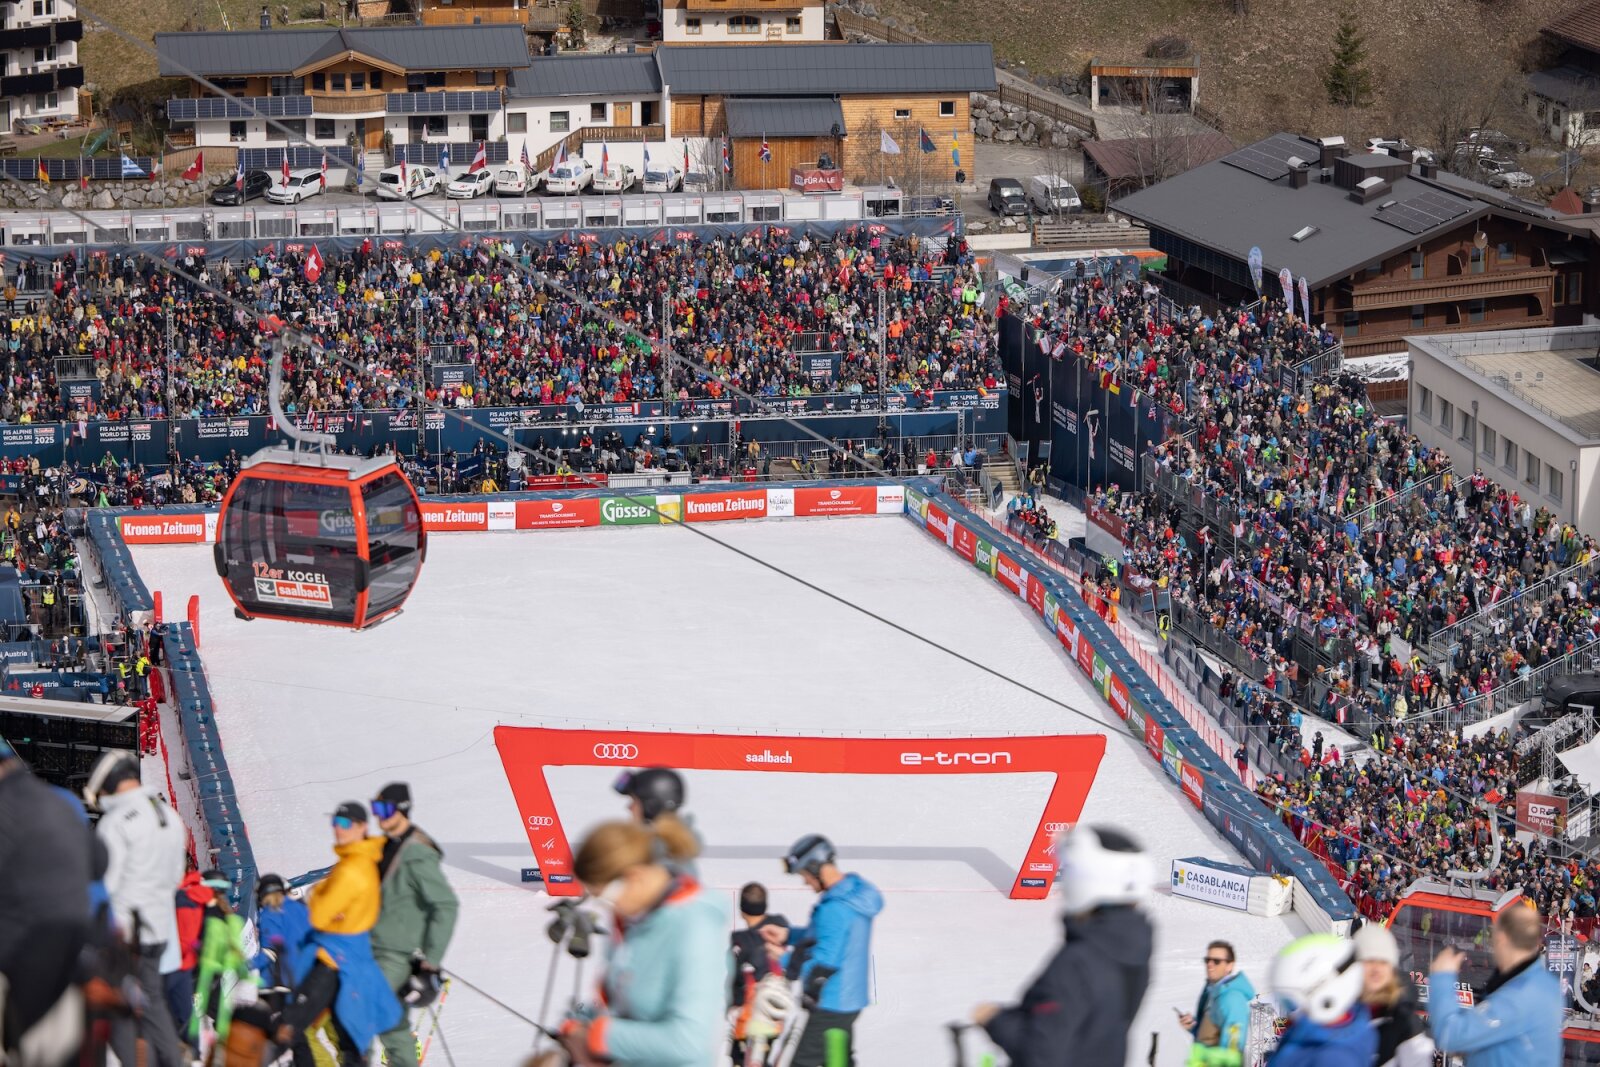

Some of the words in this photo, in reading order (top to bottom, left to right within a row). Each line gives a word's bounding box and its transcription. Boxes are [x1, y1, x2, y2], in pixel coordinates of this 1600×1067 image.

[34, 436, 54, 444] 2025
[132, 433, 151, 441] 2025
[229, 429, 249, 437] 2025
[602, 499, 654, 522] Gösser
[687, 499, 724, 514] Kronen
[725, 497, 765, 512] Zeitung
[445, 509, 485, 524] Zeitung
[124, 522, 162, 536] Kronen
[162, 521, 203, 536] Zeitung
[252, 562, 284, 580] 12er
[287, 570, 329, 584] KOGEL
[278, 582, 327, 600] saalbach
[22, 681, 33, 689] Ski
[745, 750, 792, 764] saalbach
[900, 751, 1011, 765] e-tron
[1187, 871, 1246, 894] CASABLANCA
[1185, 882, 1246, 902] hotelsoftware
